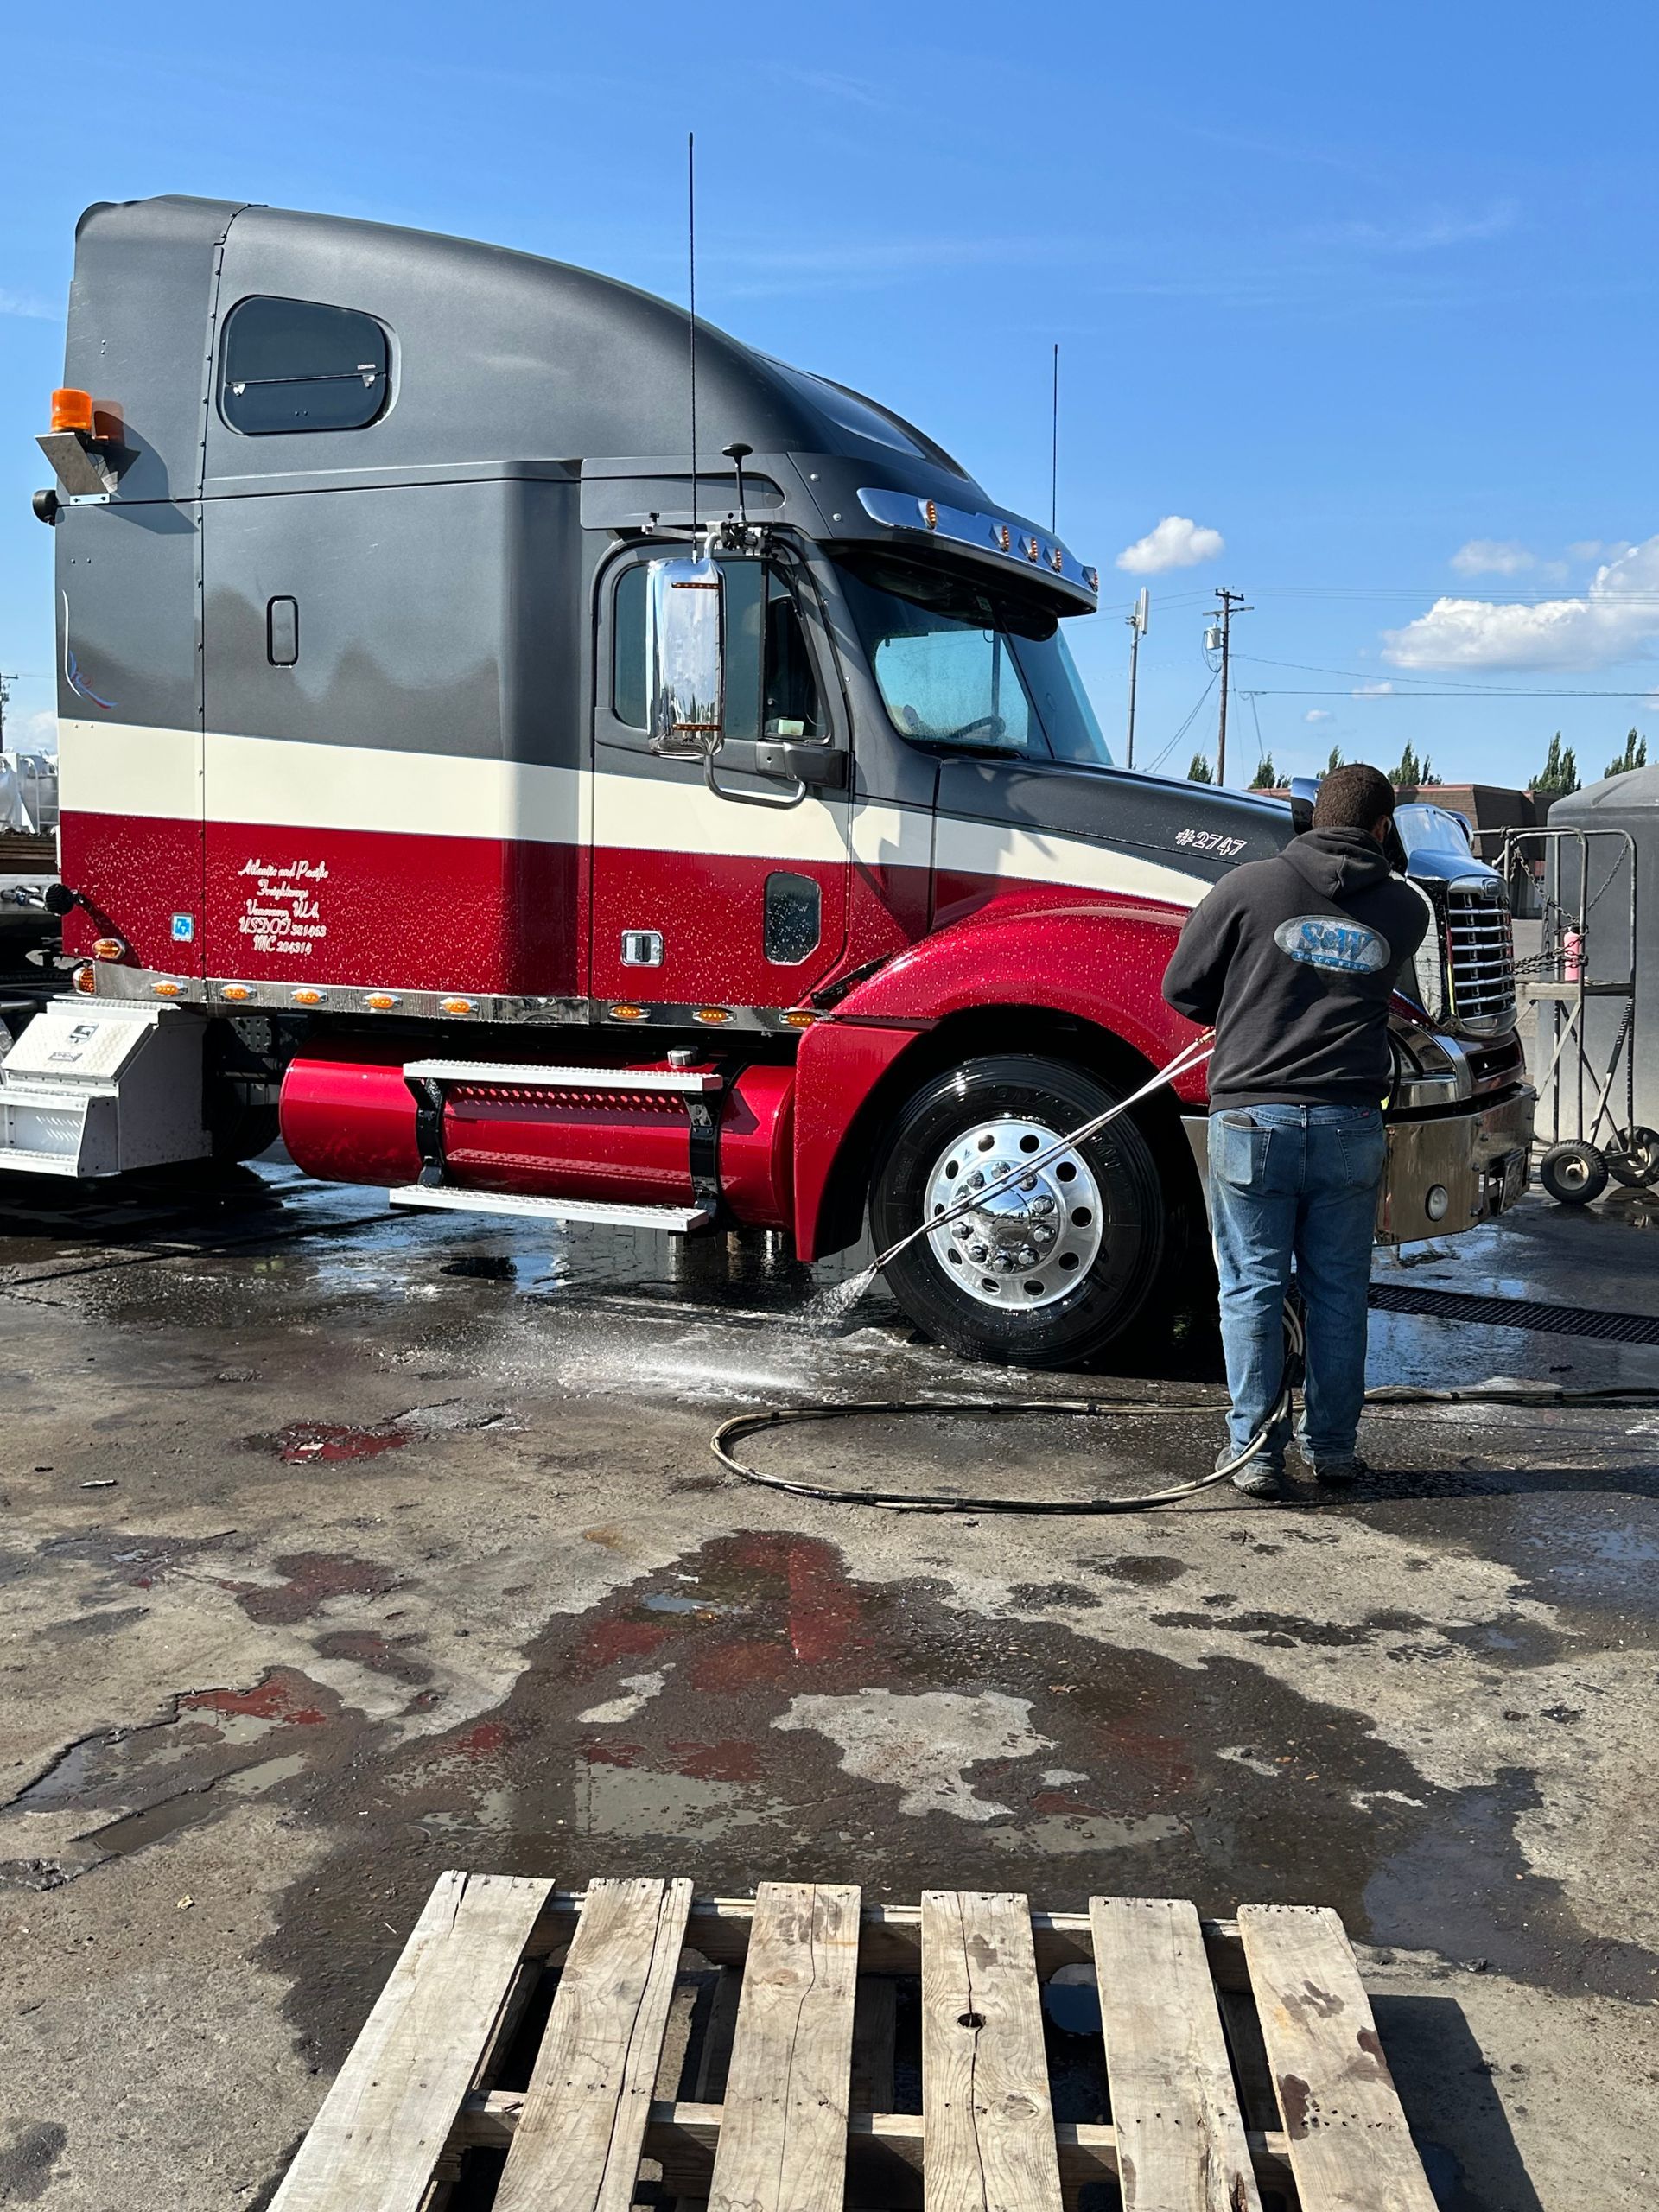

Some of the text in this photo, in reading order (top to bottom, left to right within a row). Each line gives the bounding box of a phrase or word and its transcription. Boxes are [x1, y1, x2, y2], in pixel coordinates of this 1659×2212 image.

[1175, 829, 1247, 855] #2747
[278, 861, 297, 877] and
[296, 860, 328, 882] Pacific
[253, 934, 276, 952] MC
[1298, 922, 1376, 961] S&W
